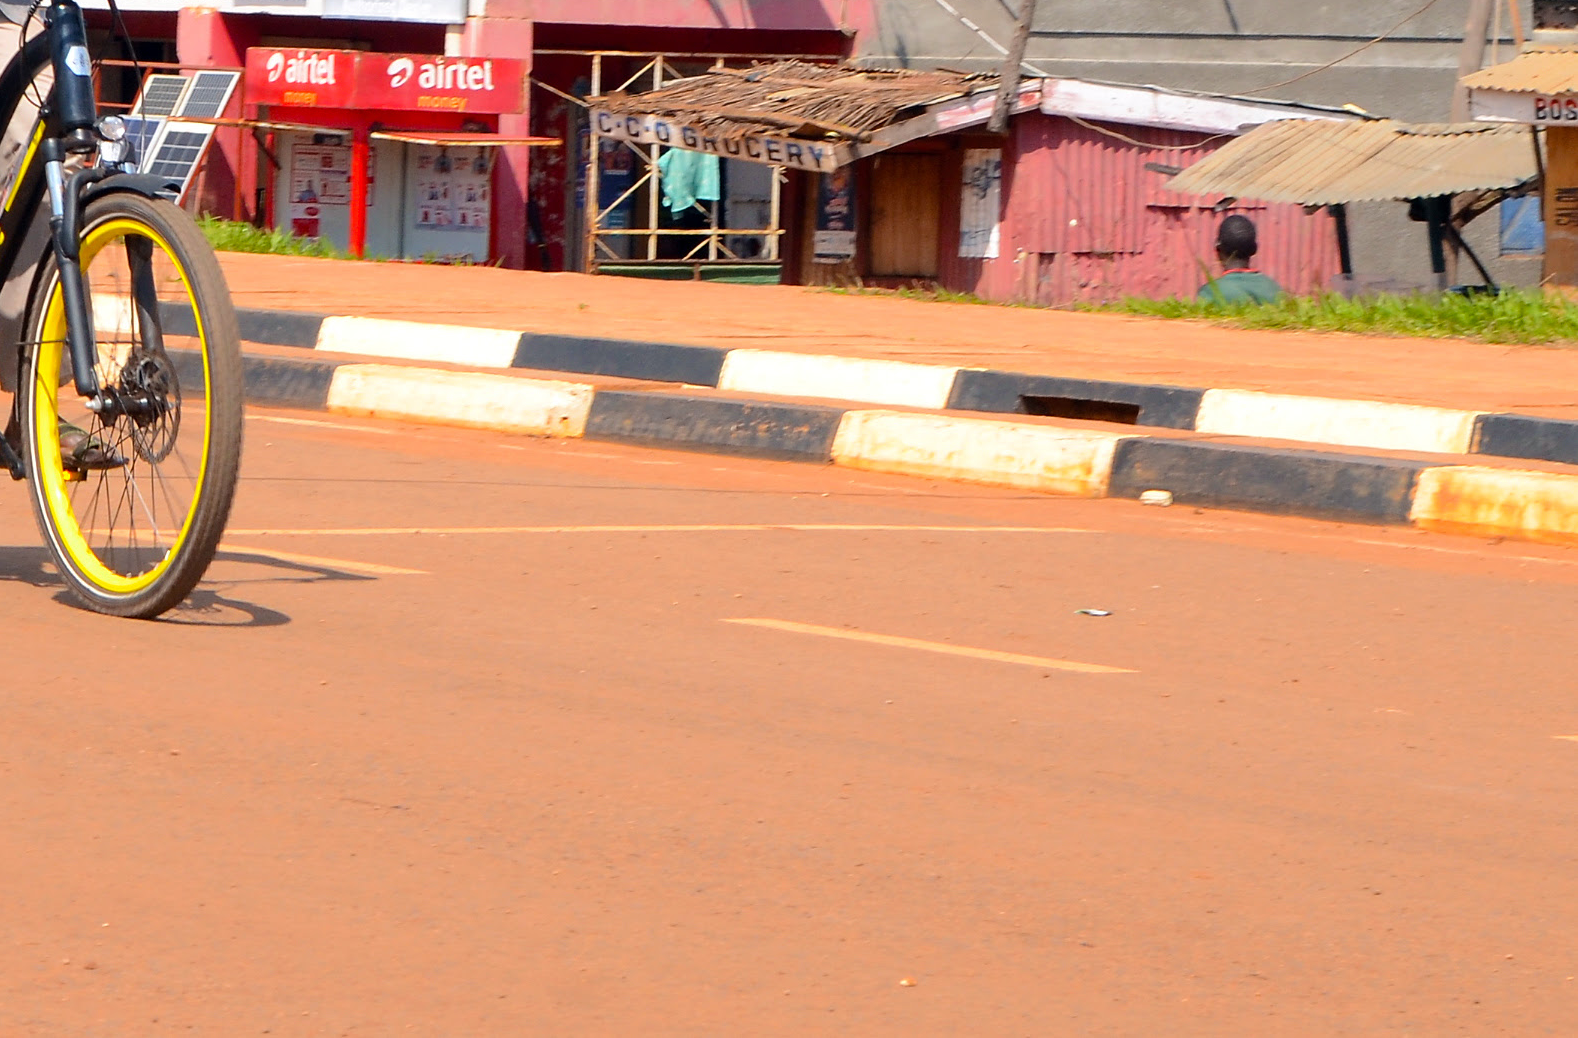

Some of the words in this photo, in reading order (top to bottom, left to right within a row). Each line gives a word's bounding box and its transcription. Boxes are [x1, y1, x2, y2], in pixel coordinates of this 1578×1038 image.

[286, 51, 336, 84] airtel
[419, 57, 495, 91] airtel
[284, 90, 317, 106] money
[418, 95, 468, 111] money
